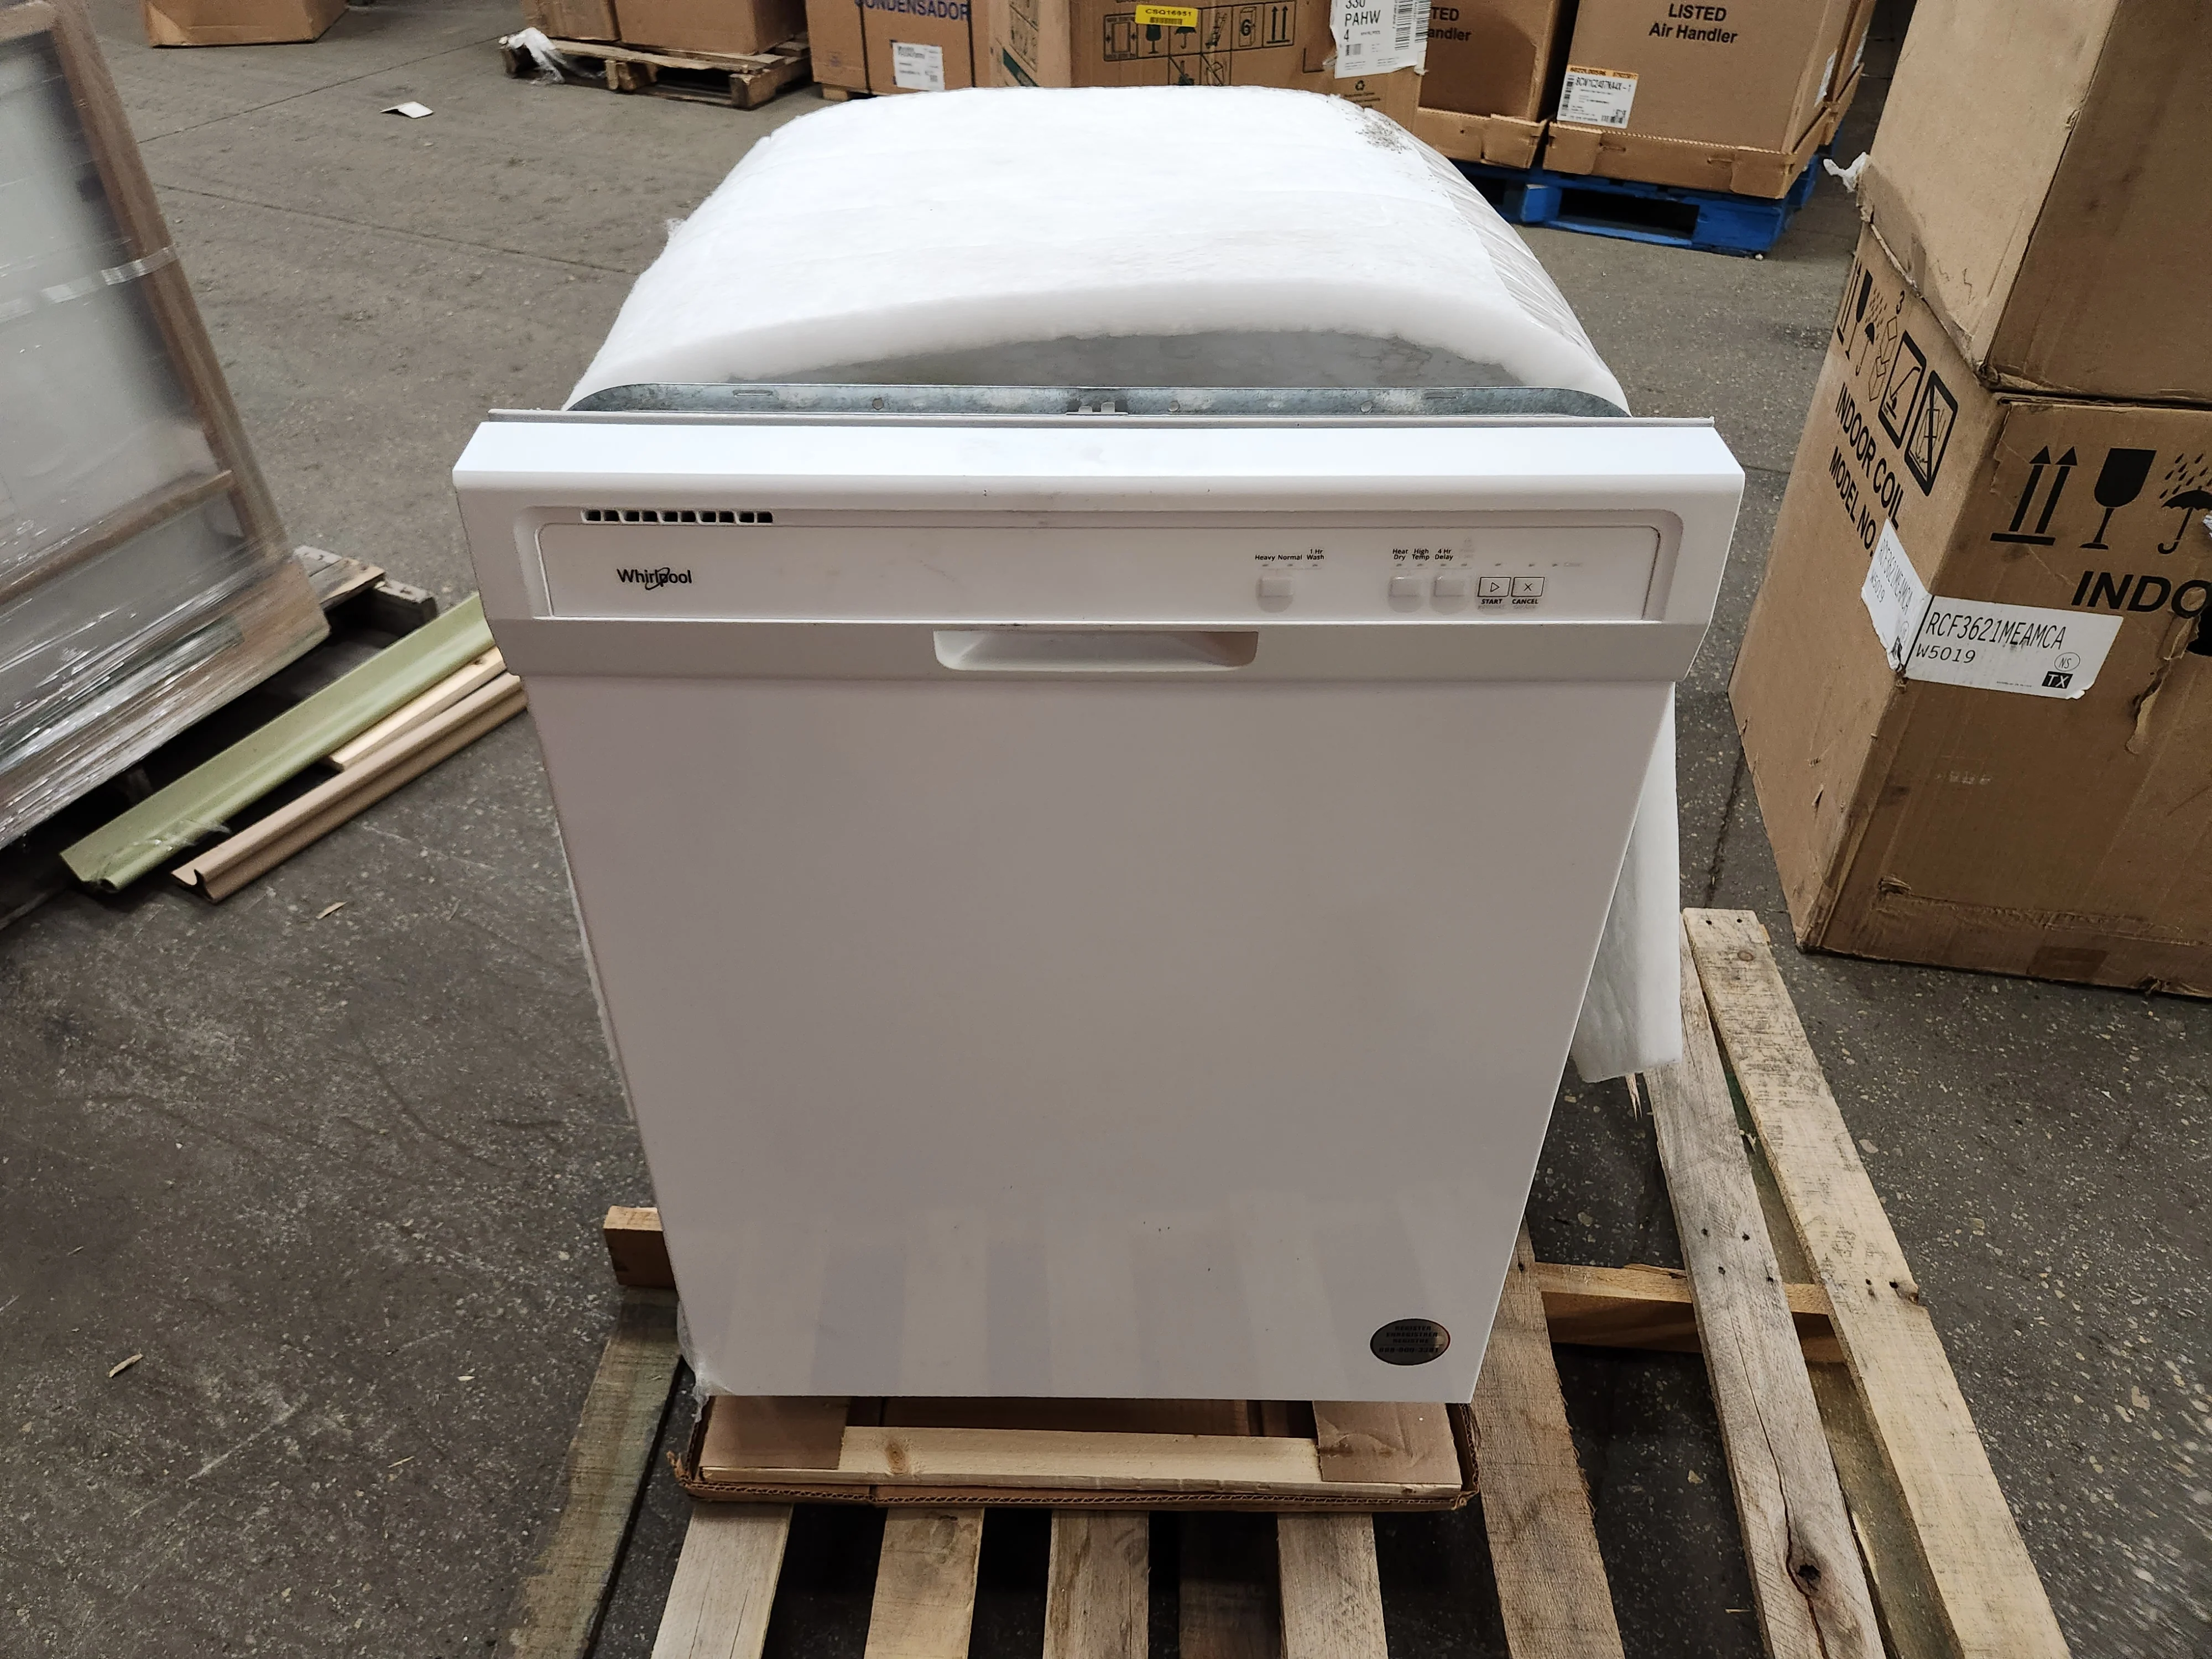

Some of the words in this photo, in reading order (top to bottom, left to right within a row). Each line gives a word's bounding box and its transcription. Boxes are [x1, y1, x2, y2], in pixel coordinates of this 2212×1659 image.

[1344, 9, 1381, 27] PAHW
[1668, 3, 1726, 22] LISTED
[1241, 19, 1251, 36] 6
[1343, 29, 1350, 43] 4
[1648, 22, 1673, 38] Air
[1676, 24, 1738, 44] Handler
[1835, 382, 1876, 478] INDOOR
[1872, 458, 1904, 530] COIL
[1829, 446, 1858, 524] MODEL
[1856, 504, 1876, 557] NO.
[617, 567, 692, 590] Whirlpool
[2071, 570, 2212, 619] INDO
[1926, 612, 2067, 650] RCF3621MEAMCA
[1916, 643, 1976, 664] W5019
[2059, 657, 2072, 669] NS
[2048, 674, 2069, 687] TX
